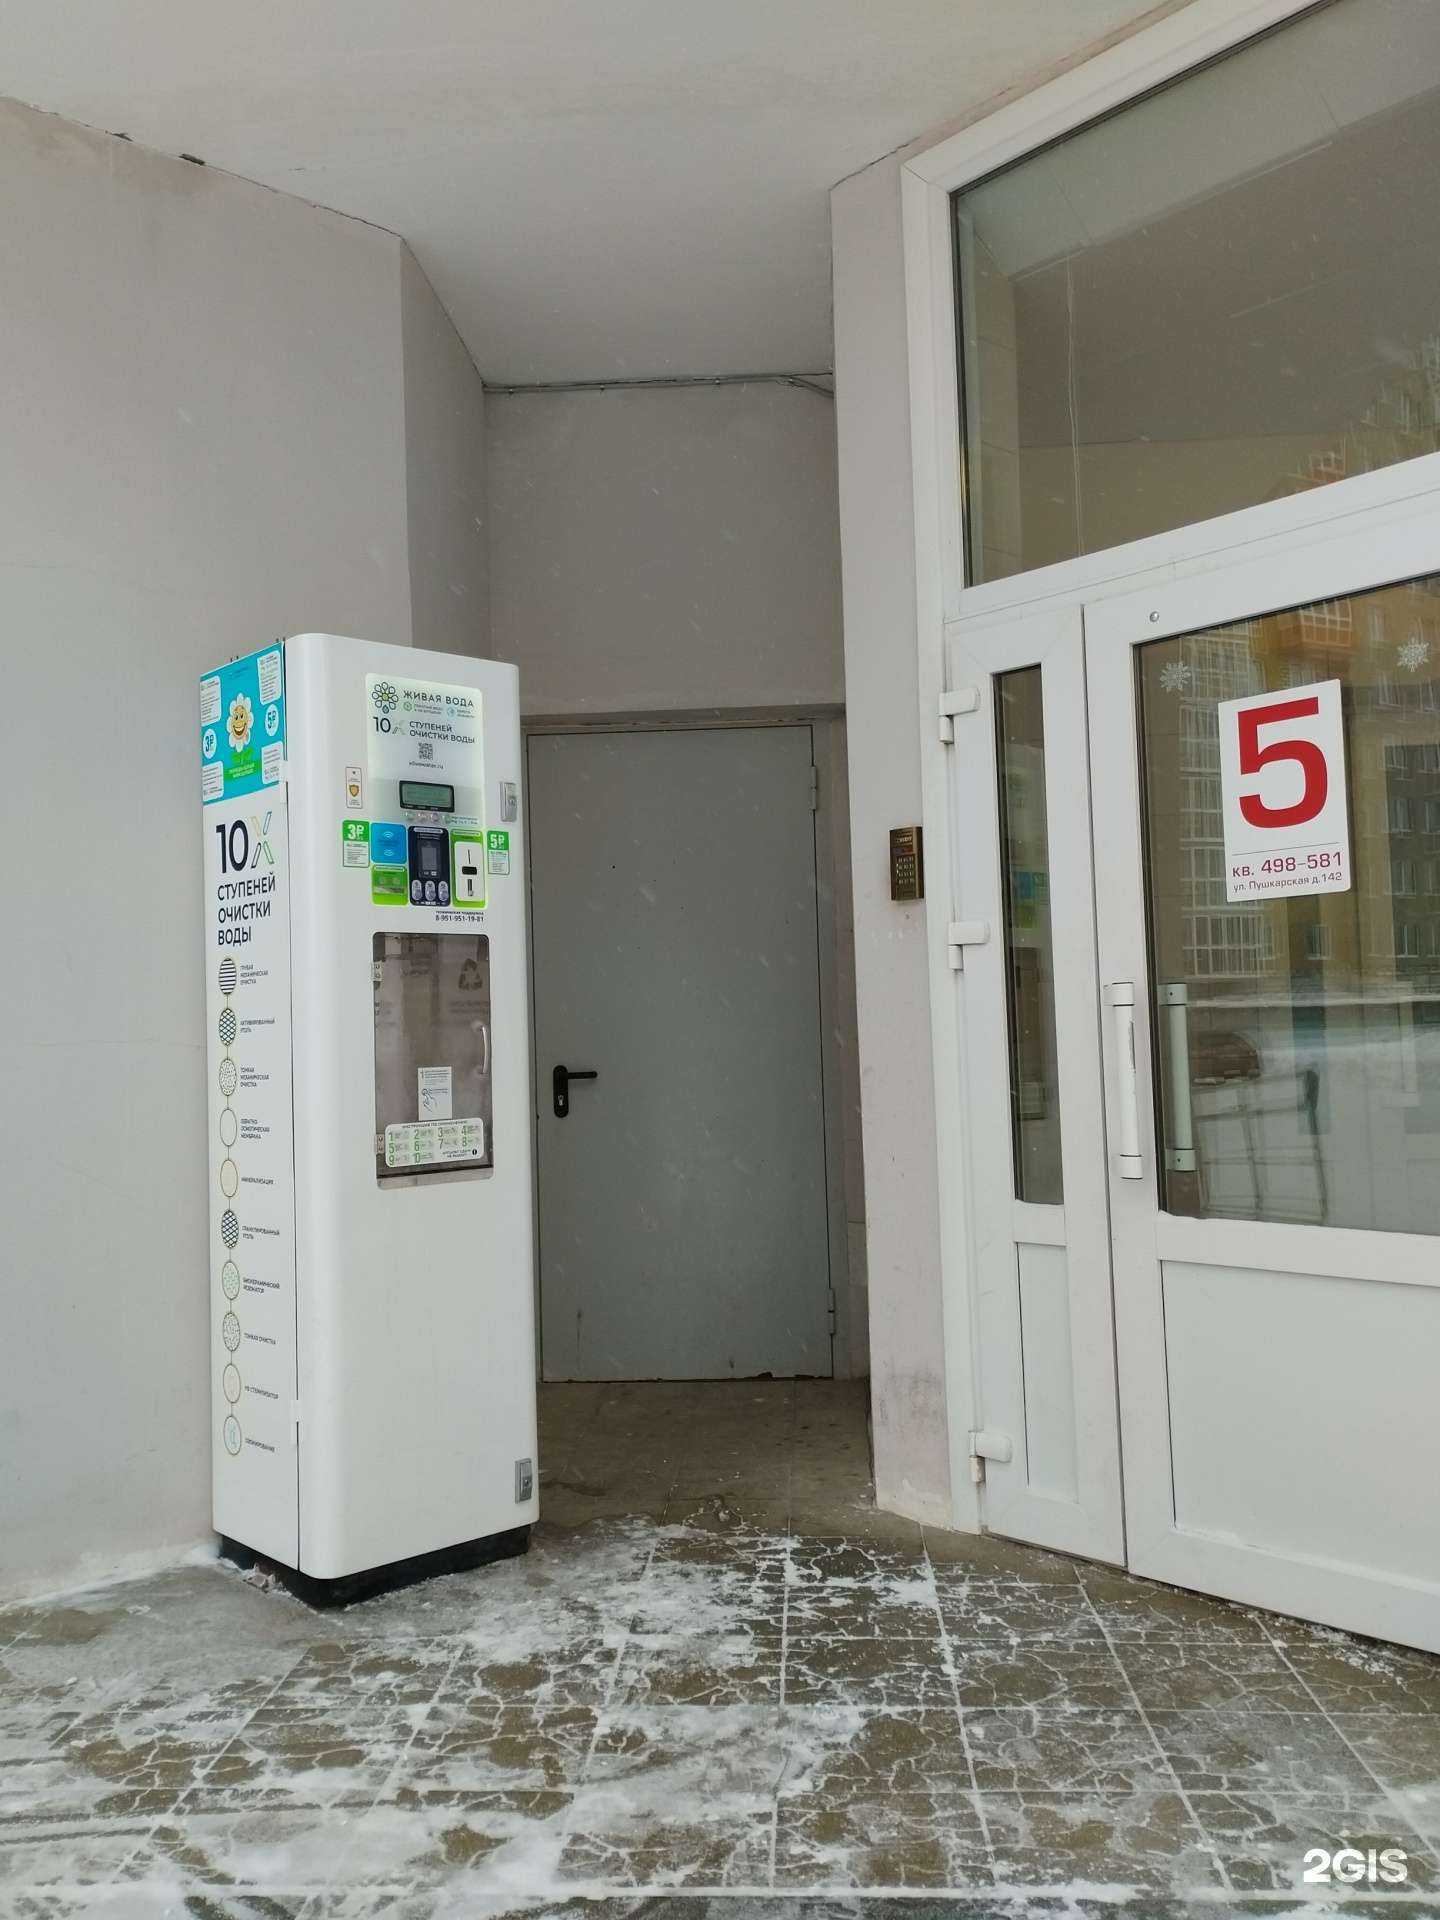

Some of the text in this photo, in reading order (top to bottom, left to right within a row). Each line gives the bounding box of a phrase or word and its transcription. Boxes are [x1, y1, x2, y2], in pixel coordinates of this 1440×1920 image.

[403, 689, 474, 708] ЖИВАЯ ВОДА
[409, 720, 453, 733] СТУПЕНЕЙ
[409, 729, 475, 744] ОЧИСТКИ ВОДЫ
[1238, 696, 1328, 829] 5
[1232, 852, 1342, 877] кв. 498-581
[217, 871, 276, 901] СТУПЕНЕЙ
[1233, 884, 1247, 893] ул.
[1249, 877, 1310, 892] Пушкарская
[218, 900, 271, 923] ОЧИСТКИ
[218, 926, 251, 947] ВОДЫ
